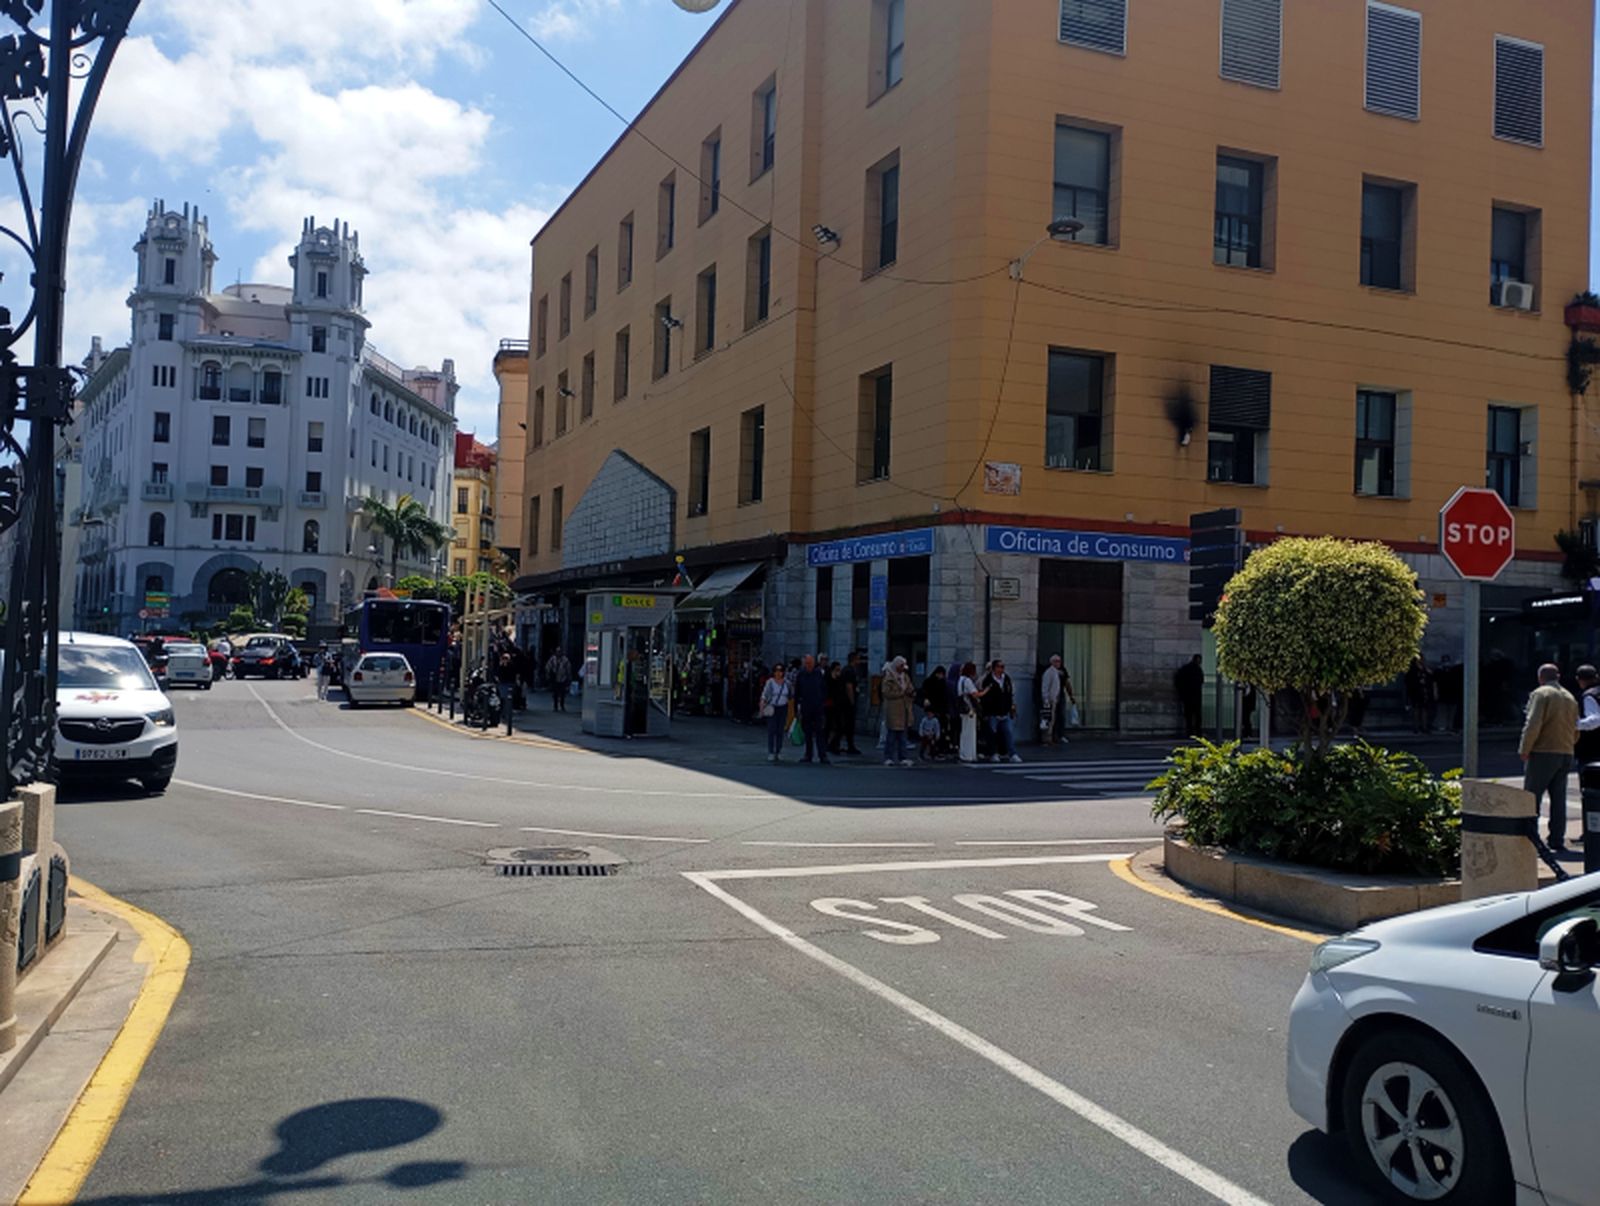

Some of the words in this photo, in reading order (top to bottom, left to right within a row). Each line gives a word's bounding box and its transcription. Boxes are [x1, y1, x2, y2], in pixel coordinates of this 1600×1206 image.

[999, 530, 1062, 553] Oficina
[1067, 535, 1089, 554] de
[1095, 538, 1176, 560] Consumo
[1447, 522, 1511, 547] STOP
[811, 546, 839, 562] Oficina
[841, 542, 852, 560] de
[853, 541, 897, 558] Consumo
[809, 889, 1136, 945] STOP
